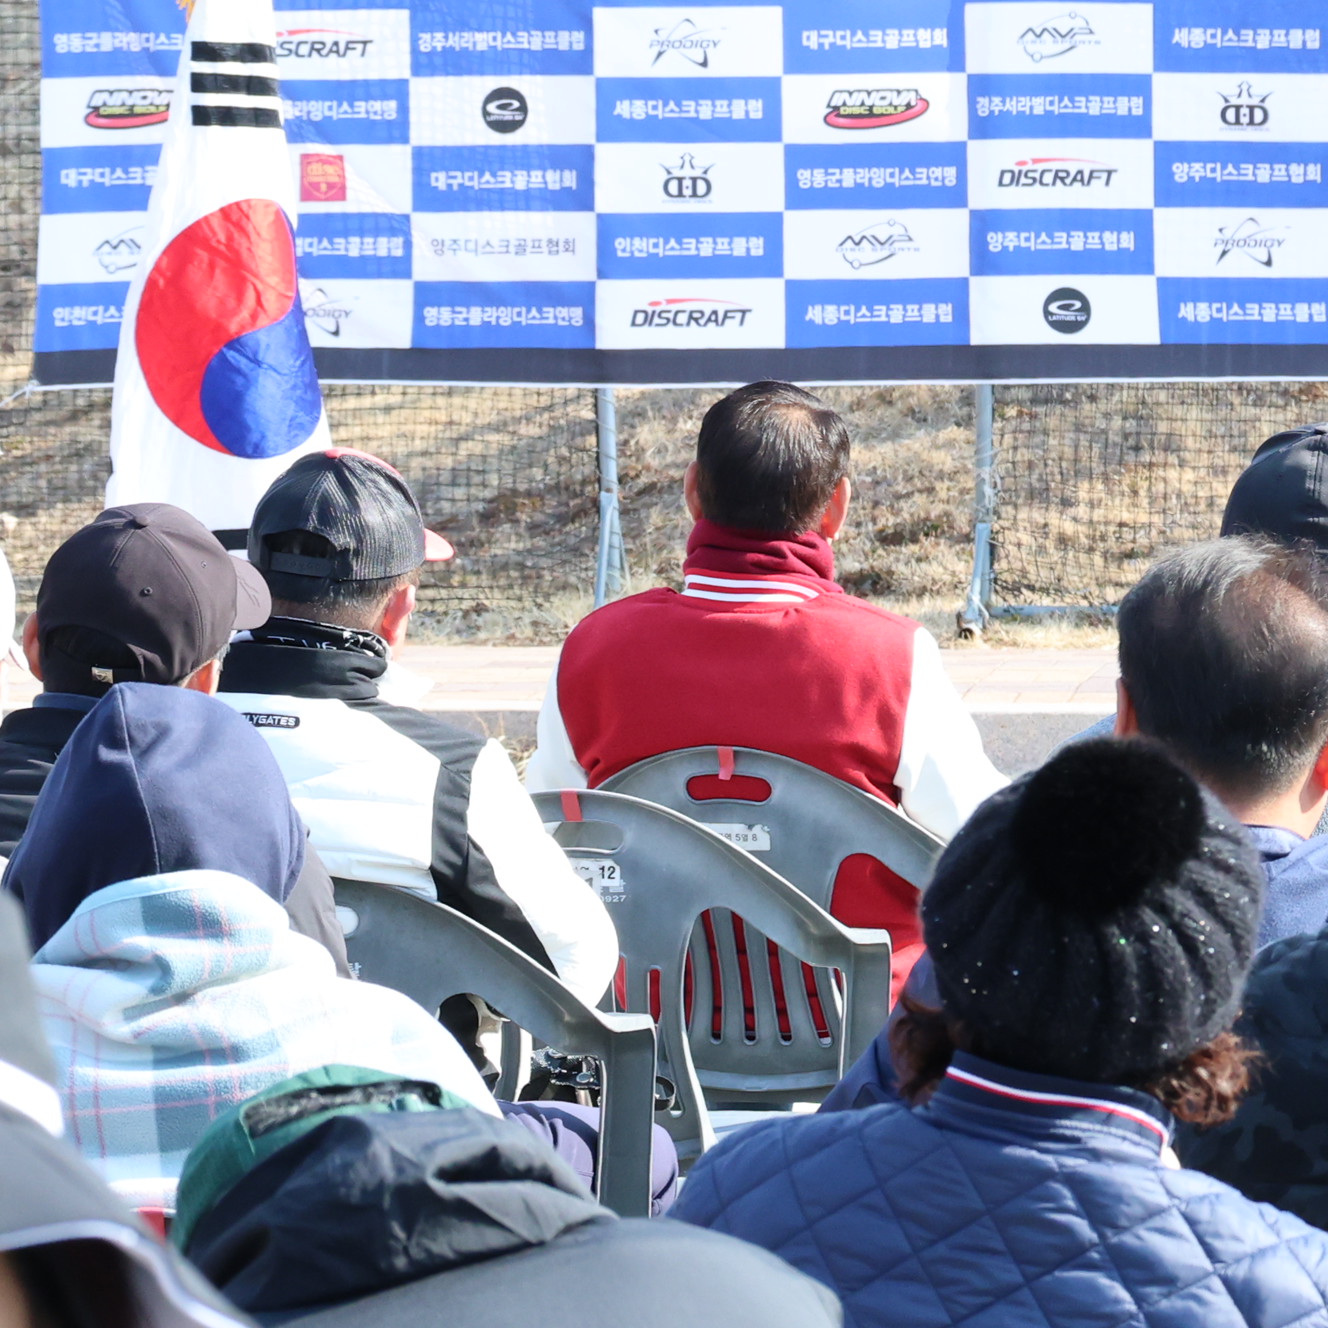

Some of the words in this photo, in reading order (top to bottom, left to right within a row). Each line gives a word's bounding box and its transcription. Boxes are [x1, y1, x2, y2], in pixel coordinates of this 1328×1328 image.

[275, 39, 374, 59] SCRAFT
[417, 29, 586, 54] 경주서라벌디스크골프클럽
[649, 36, 723, 53] PRODIGY
[801, 27, 949, 52] 대구디스크골프협회
[1172, 26, 1321, 52] 세종디스크골프클럽
[612, 98, 764, 121] 세종디스크골프클럽
[826, 88, 919, 109] INNOVA
[975, 93, 1144, 118] 경주서라벌디스크골프클럽
[430, 168, 577, 192] 대구디스크골프협회
[797, 166, 957, 190] 영동군플라잉디스크연맹
[998, 166, 1118, 190] DISCRAFT
[1172, 161, 1322, 186] 양주디스크골프협회
[431, 236, 577, 258] 양주디스크골프협회
[613, 235, 764, 258] 인천디스크골프클럽
[986, 229, 1135, 253] 양주디스크골프협회
[1213, 234, 1286, 251] PRODIGY
[52, 304, 124, 328] 인천디스
[423, 304, 584, 328] 영동군플라잉디스크연맹
[630, 308, 752, 329] DISCRAFT
[805, 303, 953, 327] 세종디스크골프클럽
[1177, 300, 1327, 325] 세종디스크골프클럽
[243, 714, 297, 727] LYGATES
[751, 833, 758, 842] 8
[599, 865, 616, 880] 12
